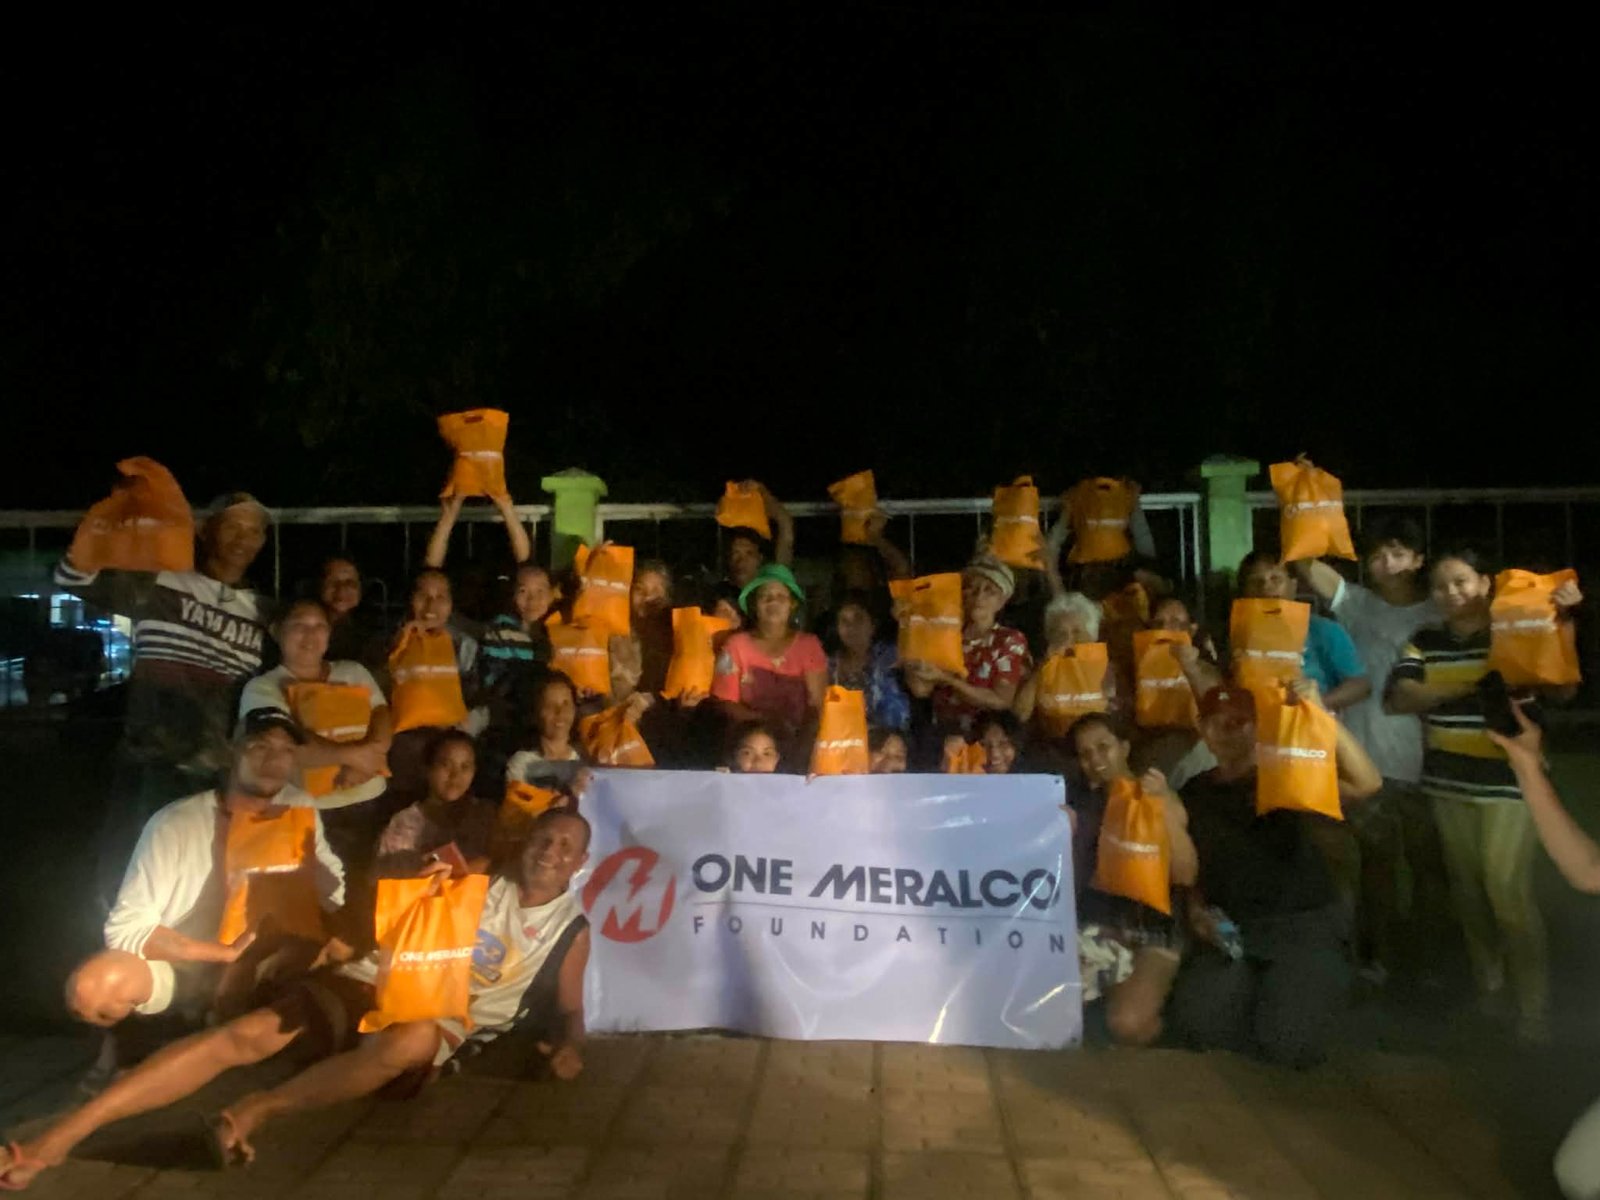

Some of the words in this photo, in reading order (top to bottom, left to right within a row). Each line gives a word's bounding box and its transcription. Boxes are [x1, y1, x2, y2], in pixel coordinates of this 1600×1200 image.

[180, 598, 262, 651] YAMAHA
[691, 853, 793, 895] ONE
[809, 863, 1062, 911] MERALCO
[399, 951, 424, 962] ONE
[692, 916, 1065, 954] FOUNDATION
